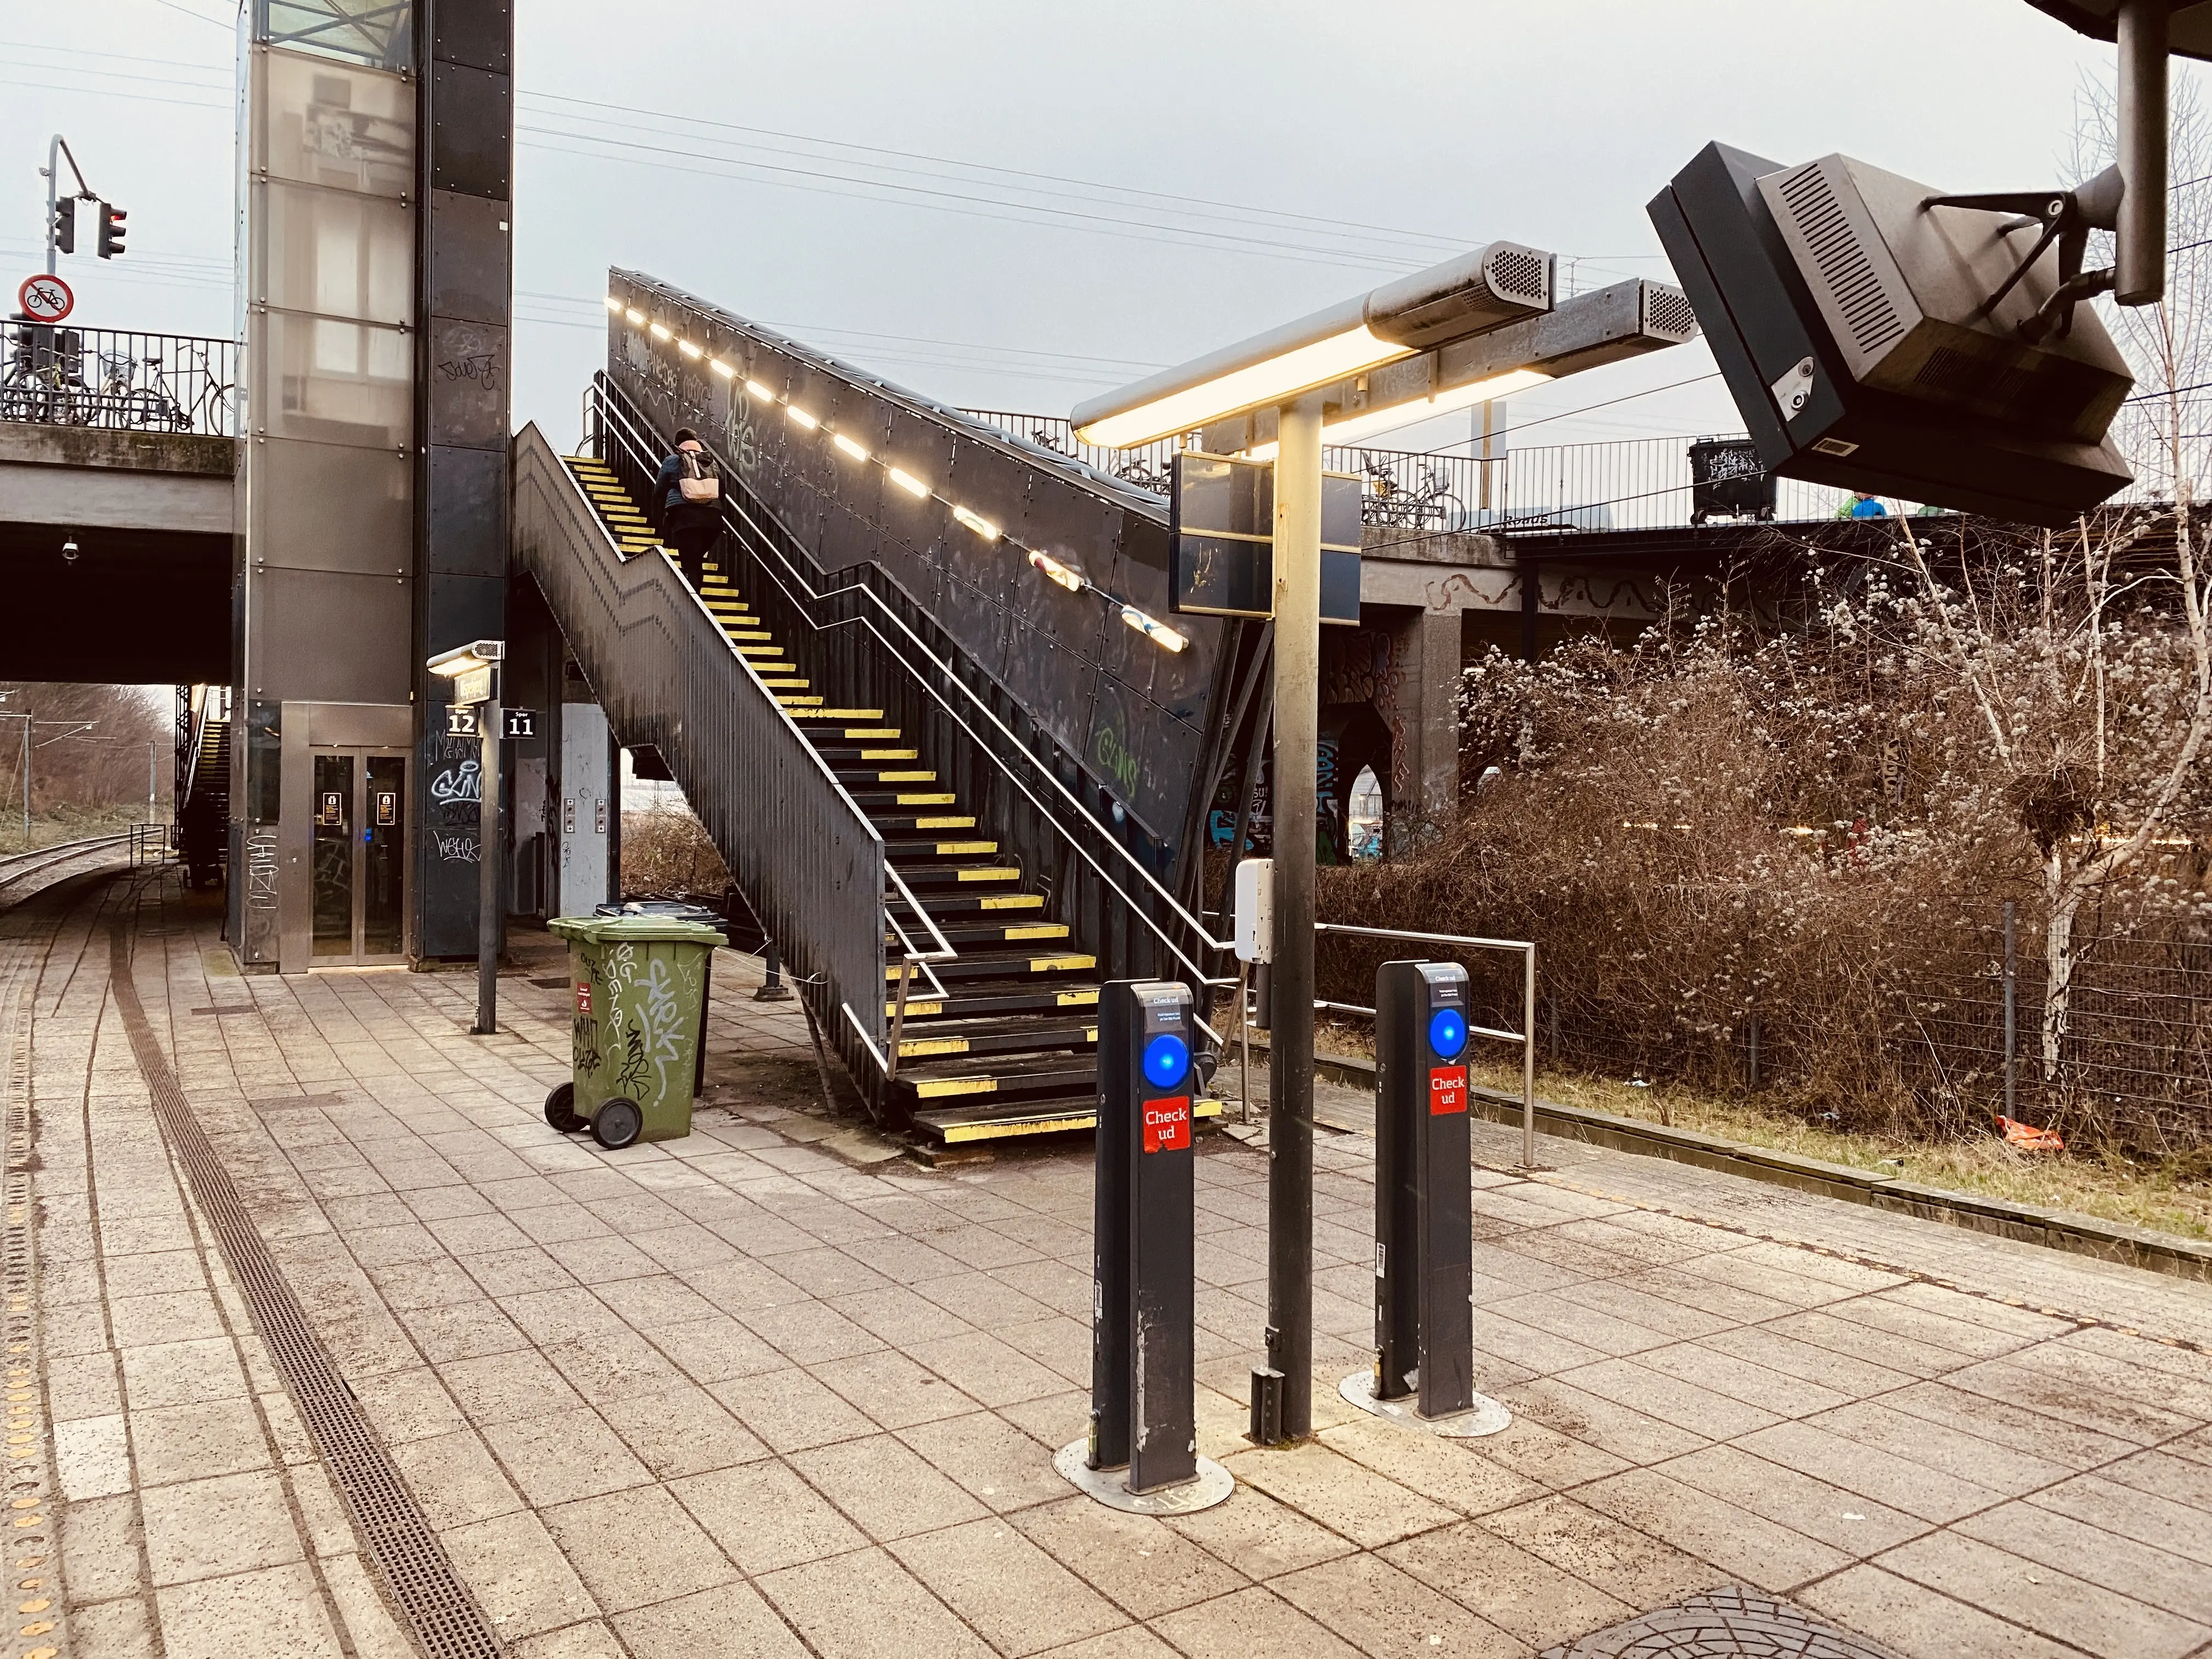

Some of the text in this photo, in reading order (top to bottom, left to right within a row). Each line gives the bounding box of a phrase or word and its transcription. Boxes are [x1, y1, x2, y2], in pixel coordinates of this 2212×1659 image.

[449, 715, 475, 733] 12
[510, 718, 533, 735] 11
[1432, 1076, 1465, 1091] Check
[1441, 1091, 1455, 1104] ud
[1146, 1108, 1187, 1125] Check
[1158, 1126, 1175, 1141] ud
